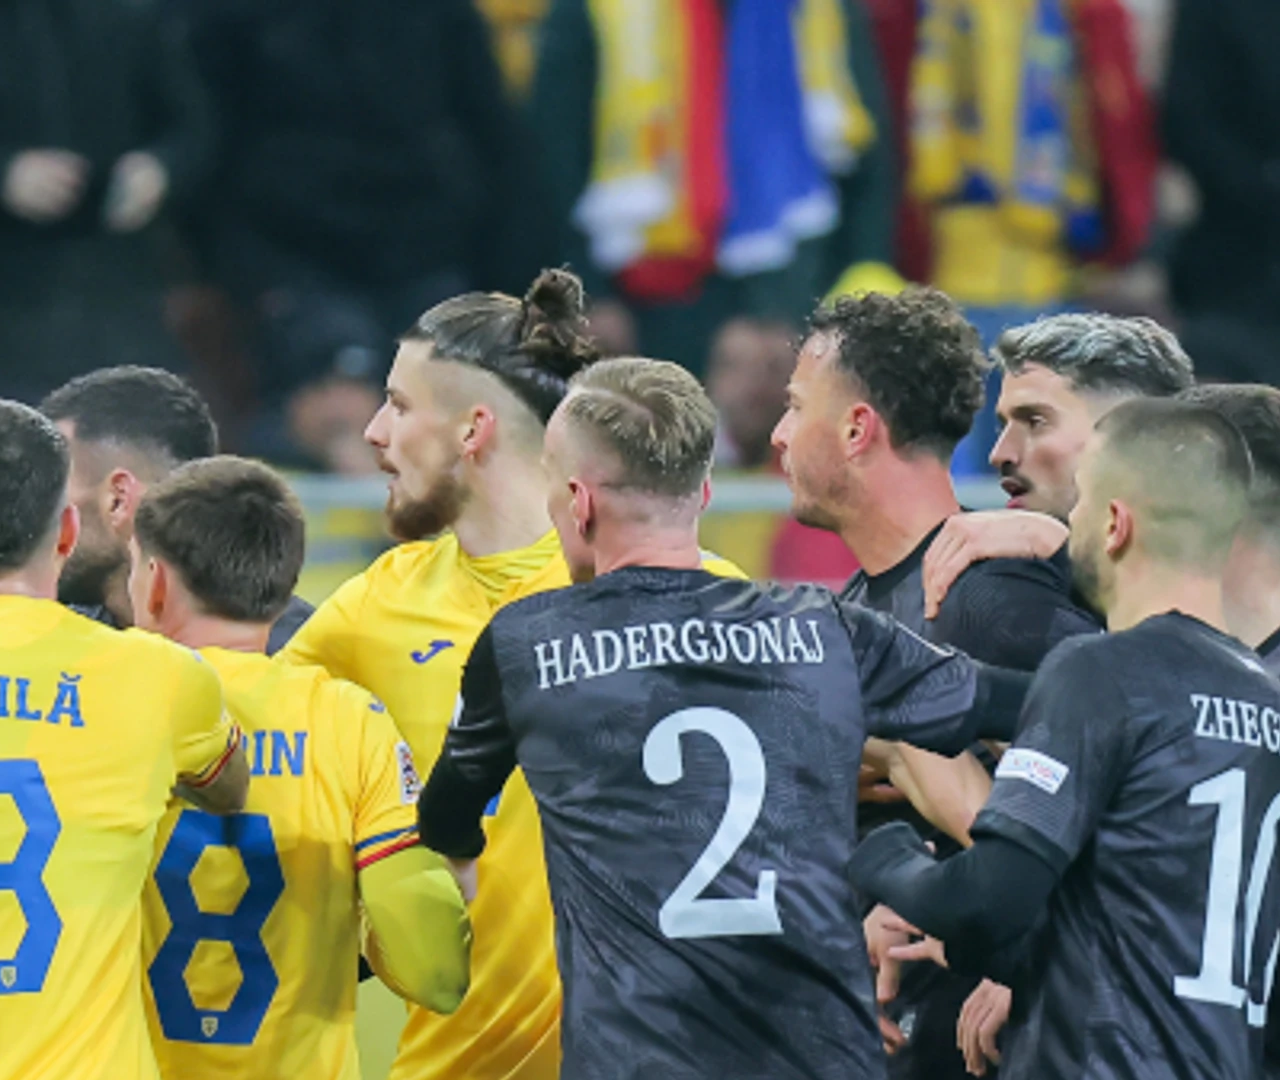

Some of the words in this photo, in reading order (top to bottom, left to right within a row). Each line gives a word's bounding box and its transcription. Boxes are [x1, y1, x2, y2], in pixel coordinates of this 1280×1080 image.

[533, 616, 824, 690] HADERGJONAJ
[147, 808, 286, 1046] 8
[642, 706, 784, 938] 2
